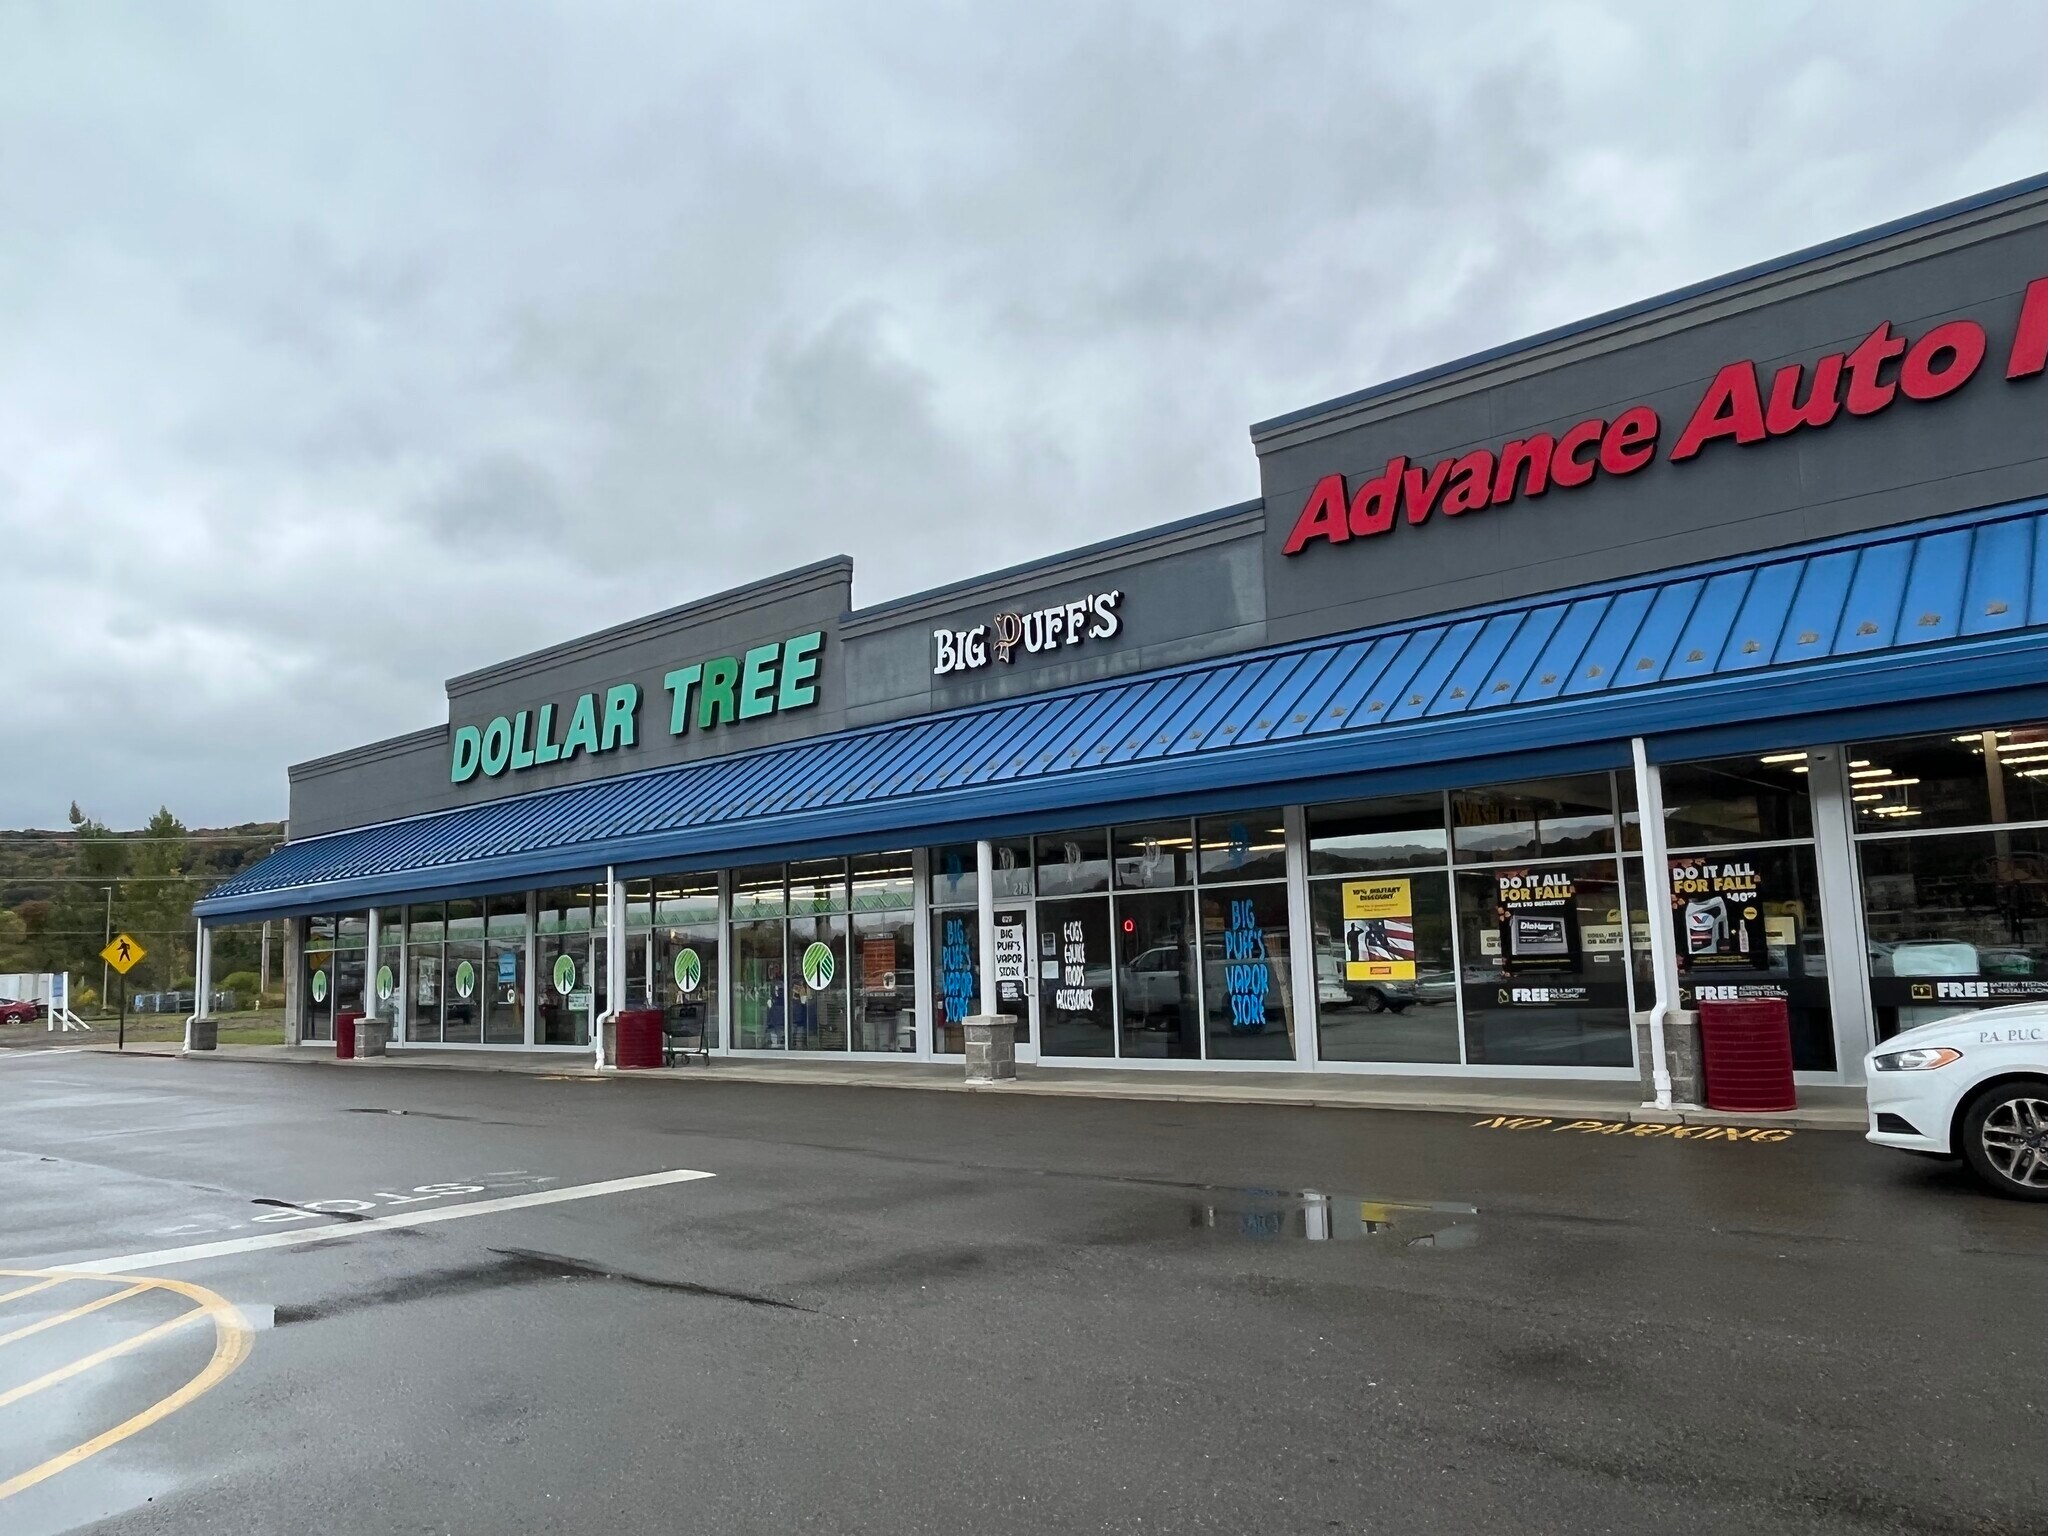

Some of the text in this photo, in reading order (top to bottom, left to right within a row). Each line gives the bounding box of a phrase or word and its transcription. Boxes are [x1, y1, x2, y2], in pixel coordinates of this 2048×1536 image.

[1281, 405, 1660, 556] Advance
[1669, 320, 1987, 463] Auto
[933, 590, 1122, 675] BIG PUFF'S
[450, 631, 826, 783] DOLLAR TREE
[1673, 863, 1754, 880] DO IT ALL
[1500, 873, 1570, 889] DO IT ALL
[1674, 877, 1756, 893] FOR FALL
[1500, 886, 1571, 901] FOR FALL
[1231, 899, 1255, 930] BIG
[946, 919, 964, 946] BIG
[1520, 921, 1554, 930] DieHard
[1001, 929, 1014, 939] BIG
[997, 941, 1021, 951] PUFF'S
[1224, 928, 1266, 961] PUFF'S
[996, 954, 1023, 963] VAPOR
[999, 966, 1020, 977] STORE
[1225, 964, 1270, 995] VAPOR
[942, 971, 973, 998] VAPOR
[1695, 985, 1738, 1000] FREE
[1937, 982, 1989, 998] FREE
[1512, 988, 1549, 1002] FREE
[1231, 993, 1266, 1026] STORE
[1471, 1117, 1796, 1143] NO PARKING
